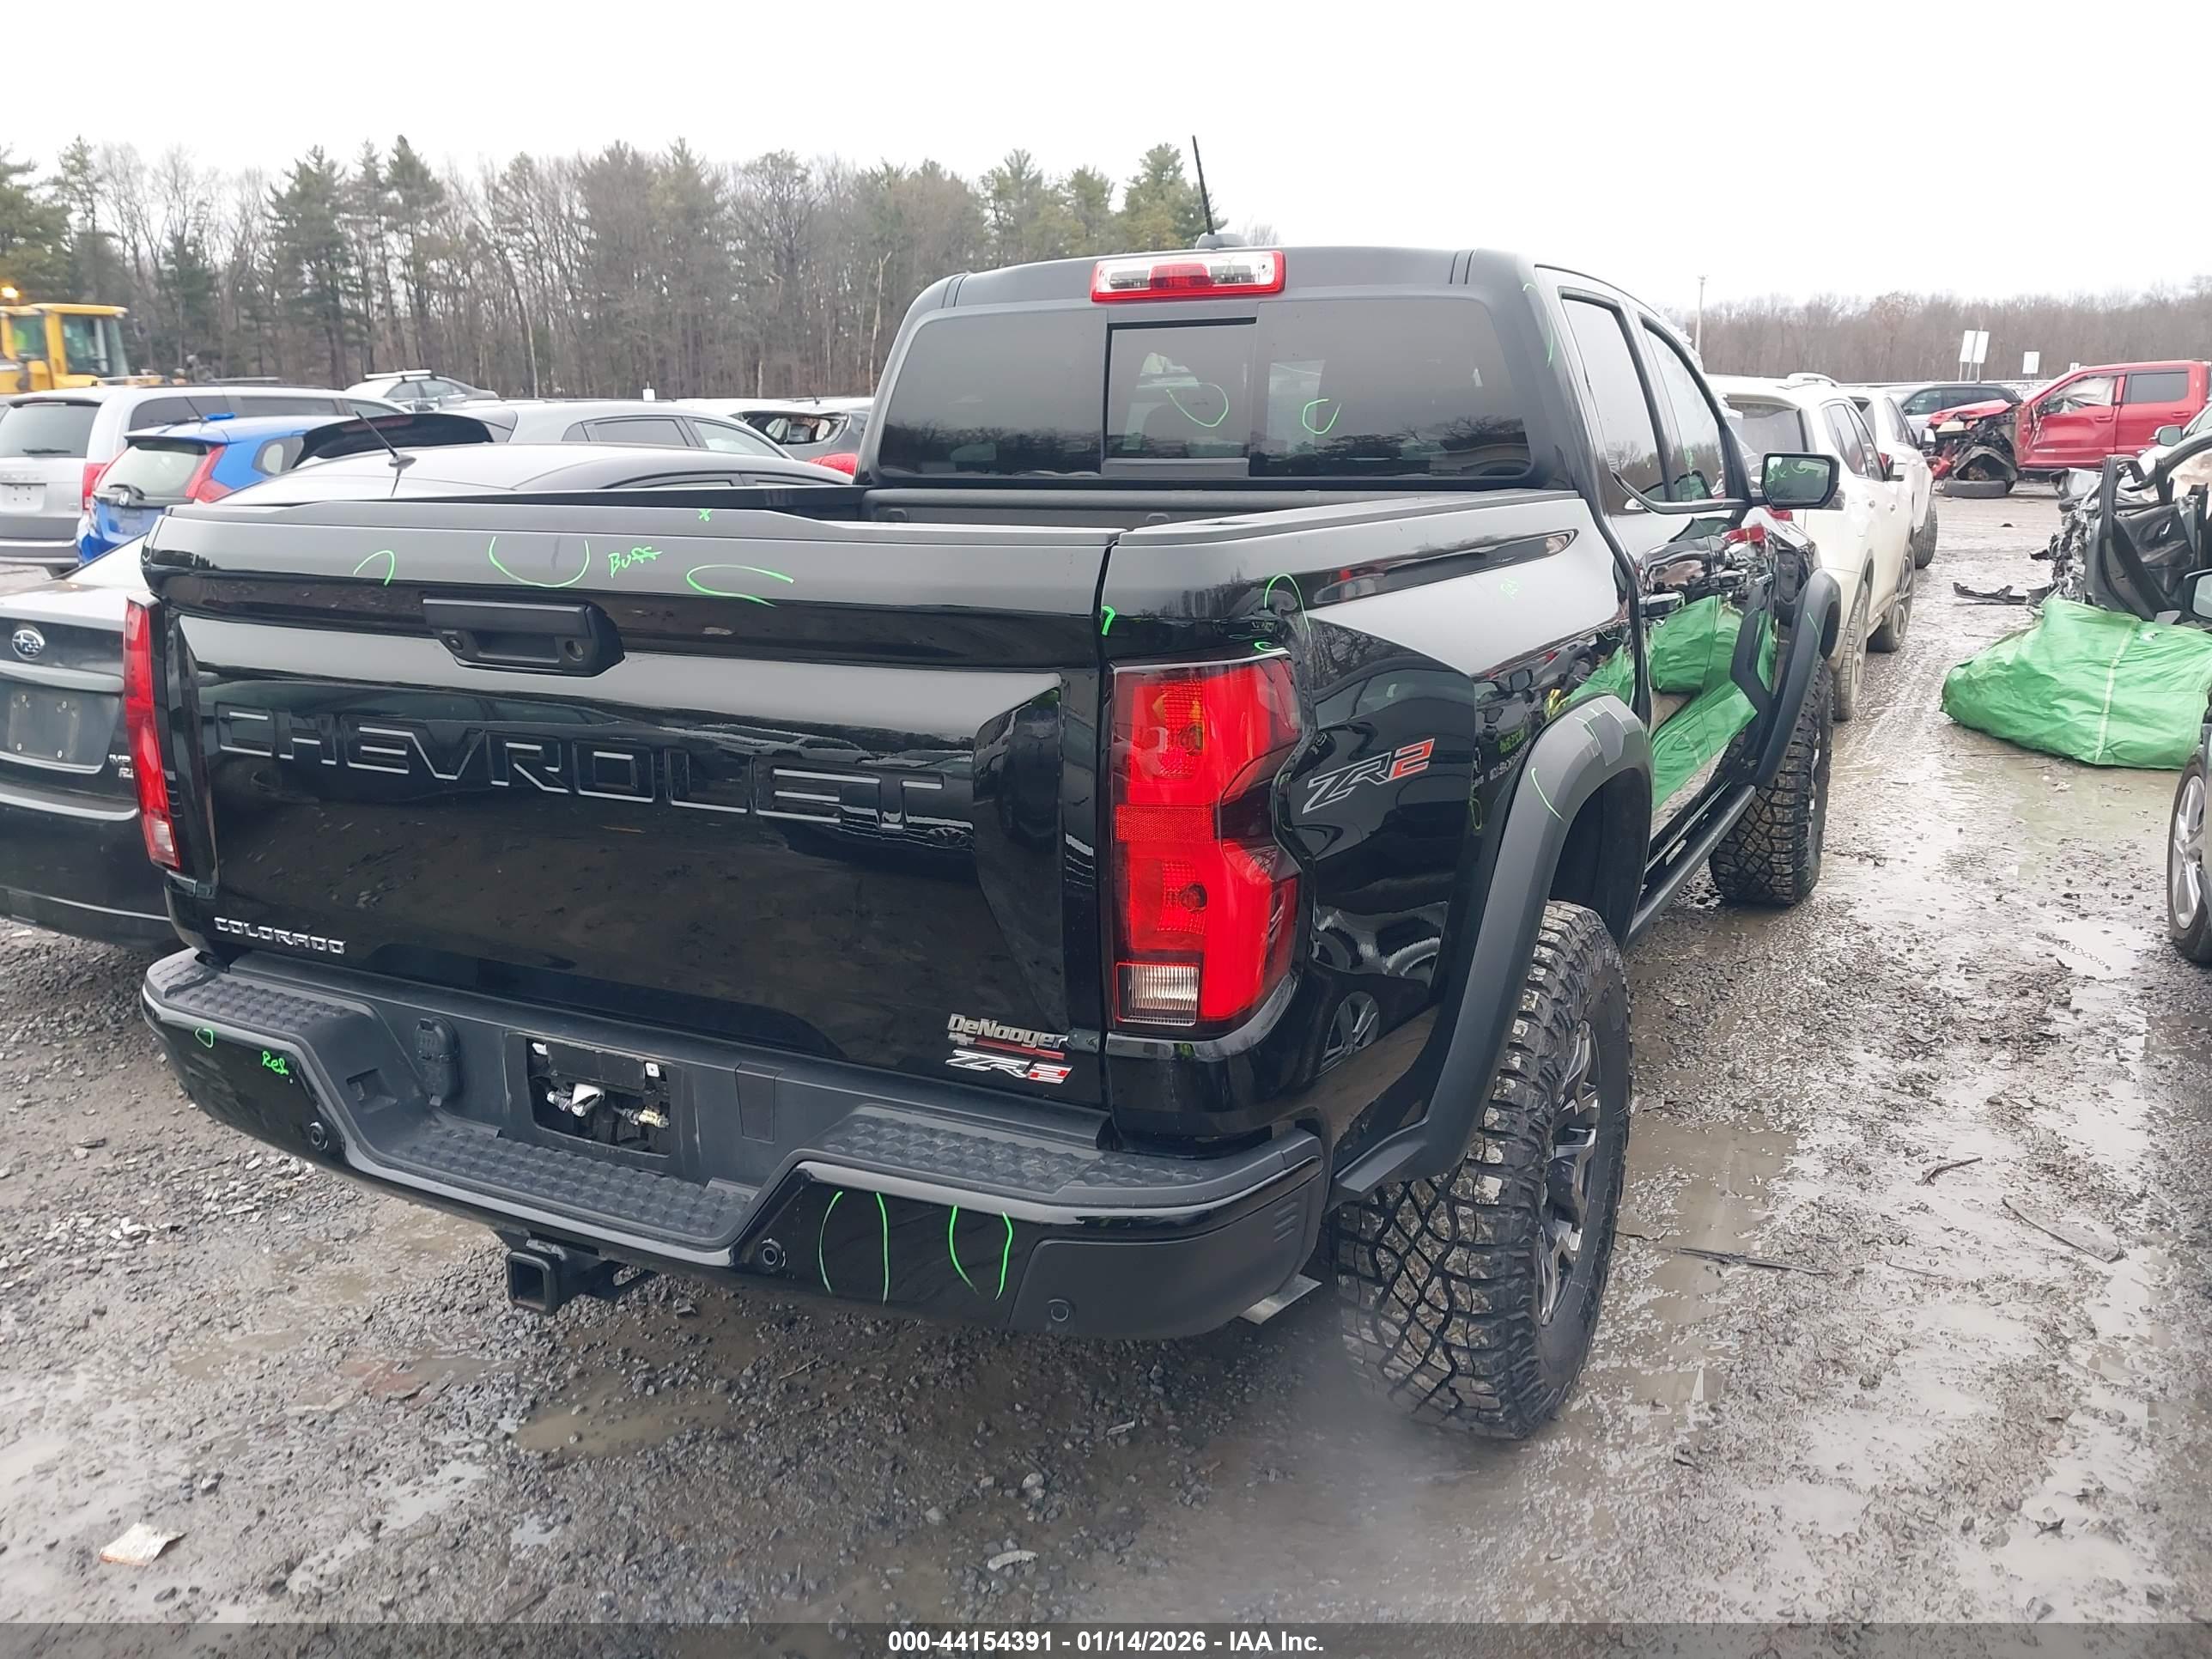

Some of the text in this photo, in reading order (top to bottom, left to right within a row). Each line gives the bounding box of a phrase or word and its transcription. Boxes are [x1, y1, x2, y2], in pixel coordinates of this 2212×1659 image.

[216, 702, 944, 830] CHEVROLET
[1301, 738, 1436, 815] ZR2
[214, 916, 346, 955] COLORADO
[945, 1048, 1073, 1084] ZR2
